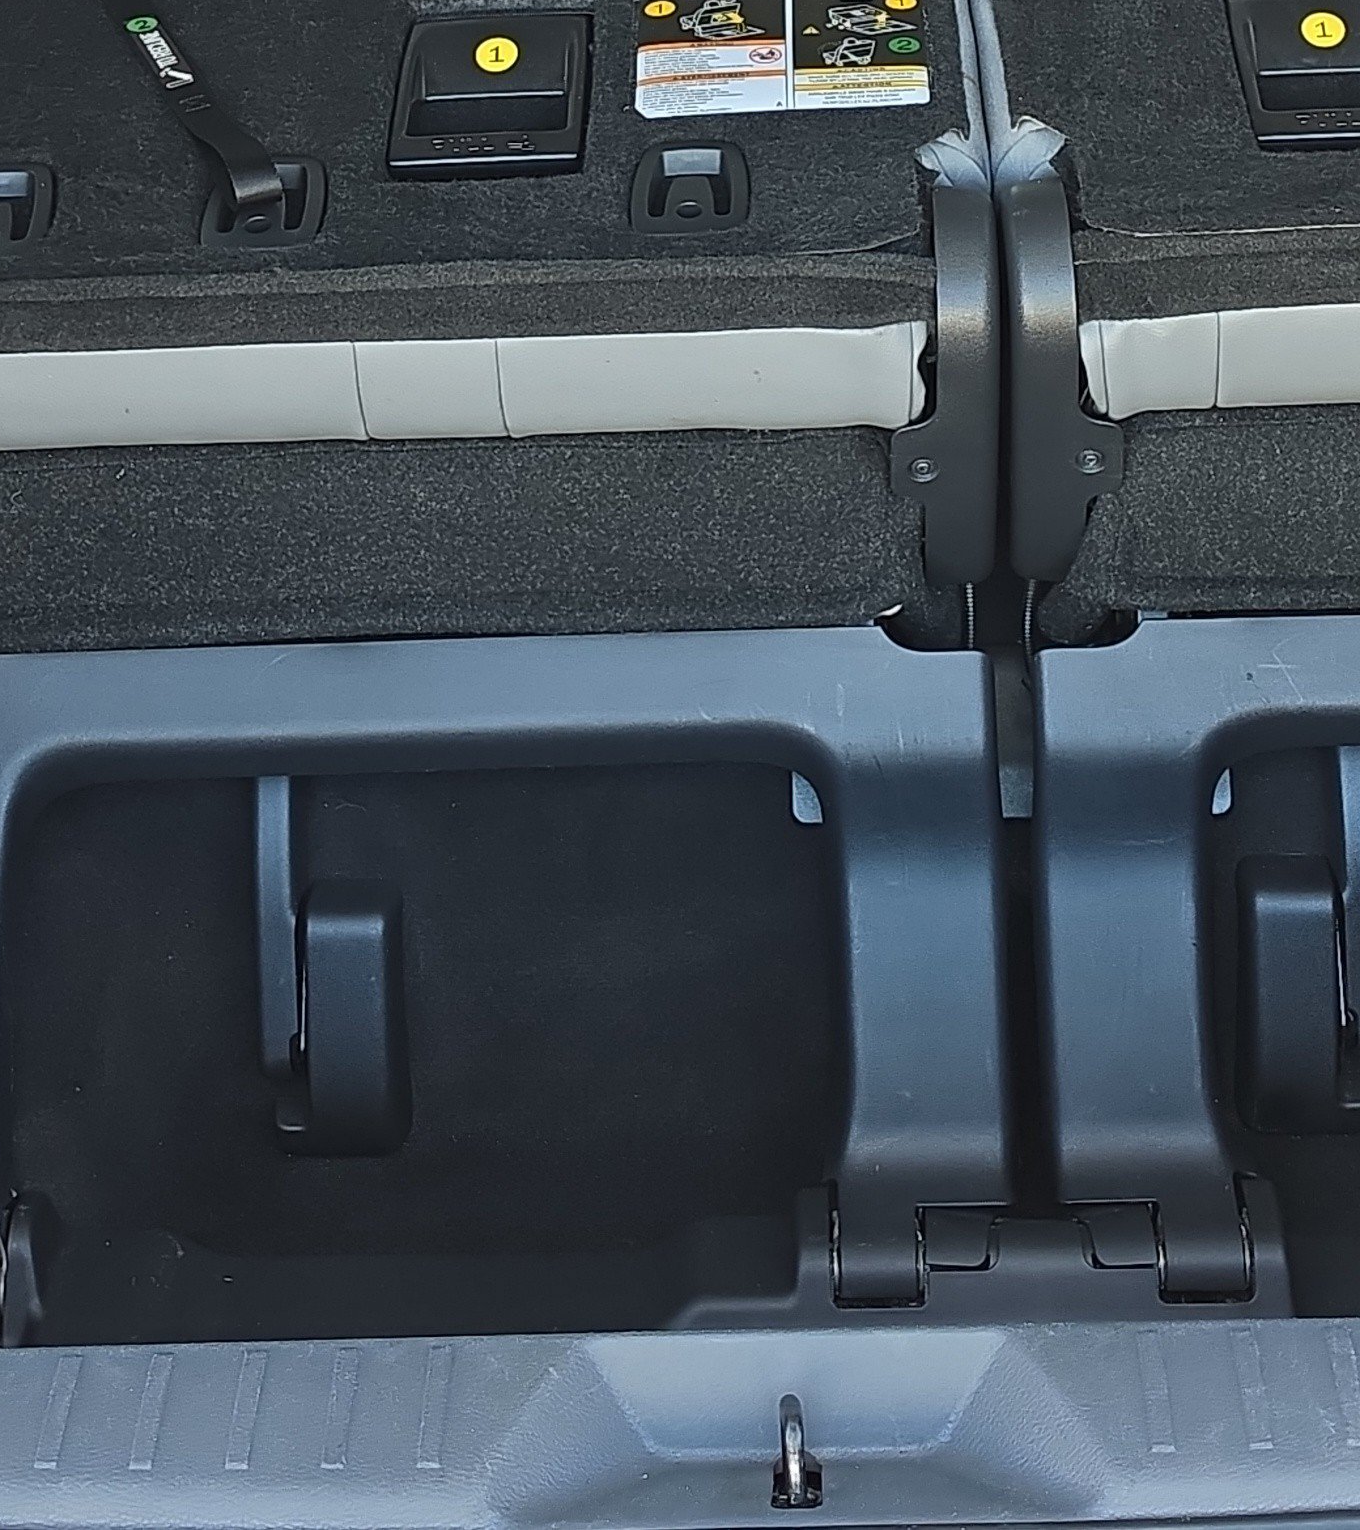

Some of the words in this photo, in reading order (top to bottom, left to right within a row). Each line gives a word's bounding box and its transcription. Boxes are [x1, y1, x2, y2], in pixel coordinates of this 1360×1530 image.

[1314, 21, 1333, 38] 1
[896, 38, 913, 51] 2
[487, 45, 506, 64] 1
